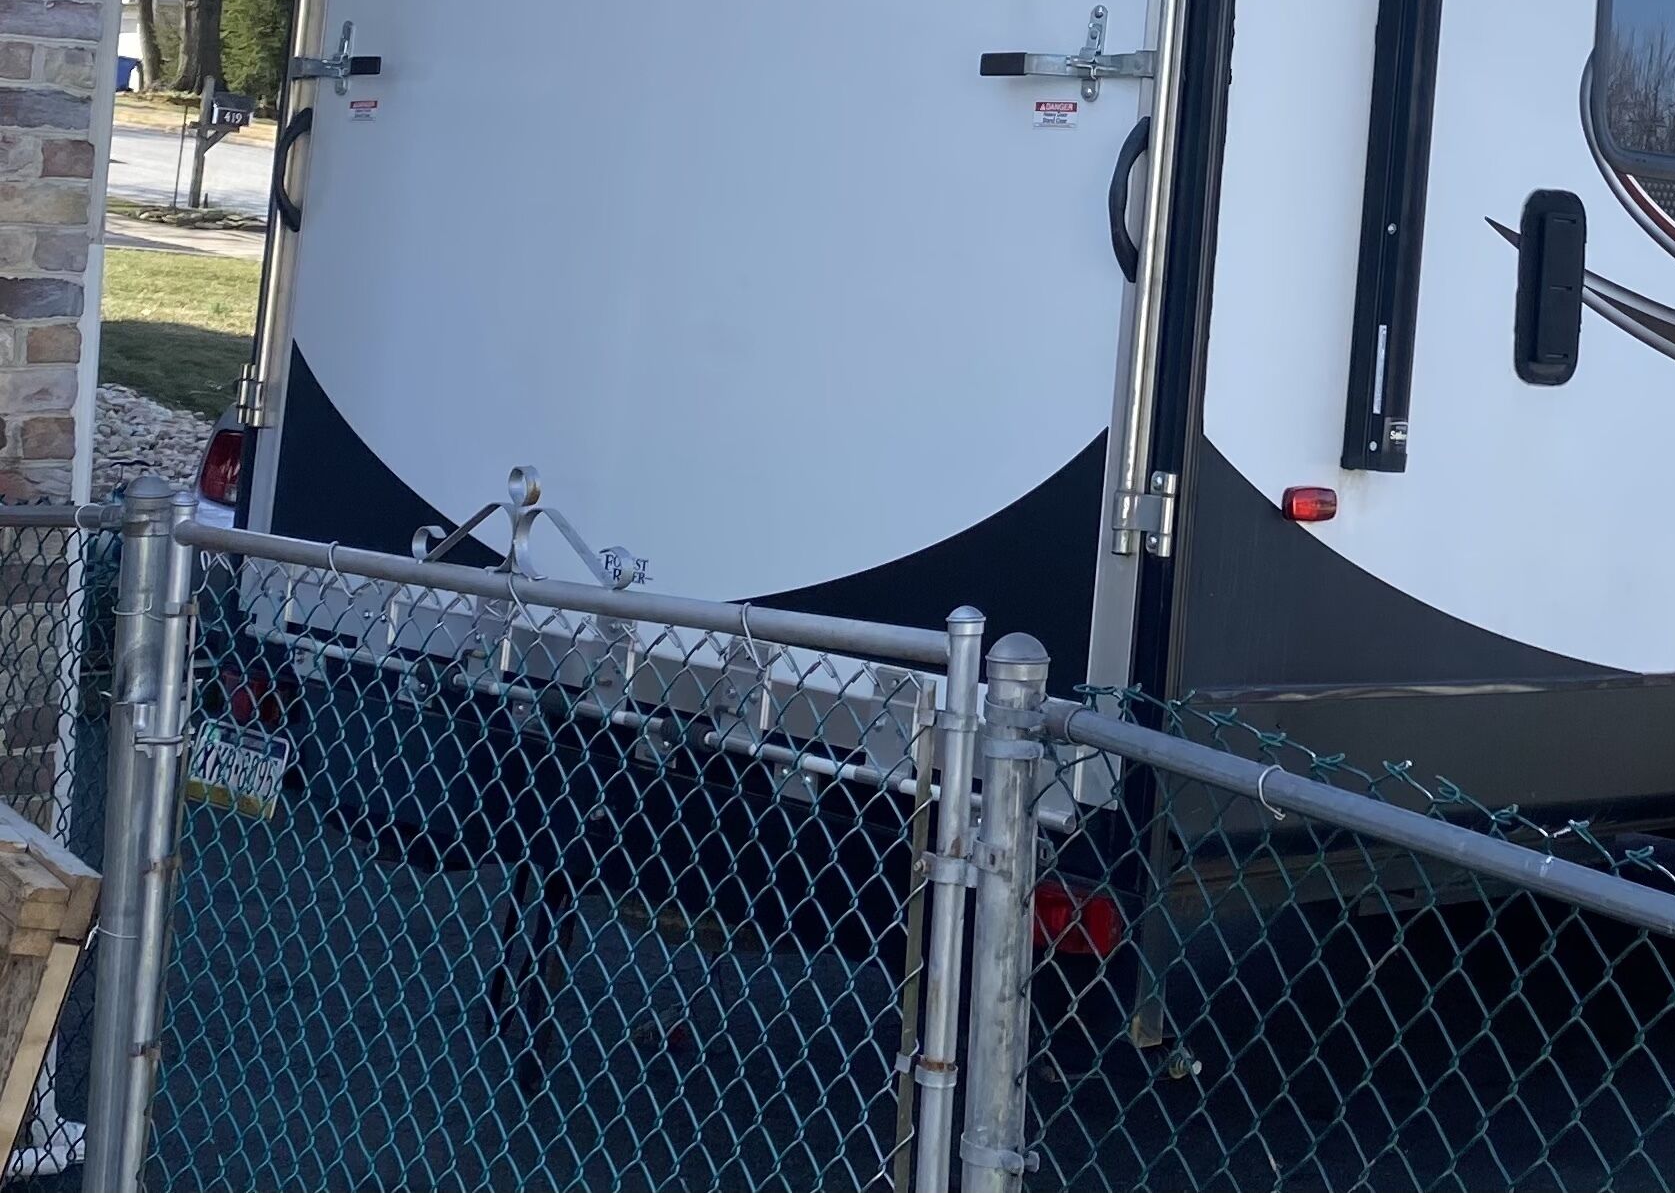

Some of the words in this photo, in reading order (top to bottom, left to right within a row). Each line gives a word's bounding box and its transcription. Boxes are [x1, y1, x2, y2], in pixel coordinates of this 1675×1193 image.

[224, 111, 243, 124] 419
[604, 554, 649, 572] FOST
[613, 568, 646, 584] RER
